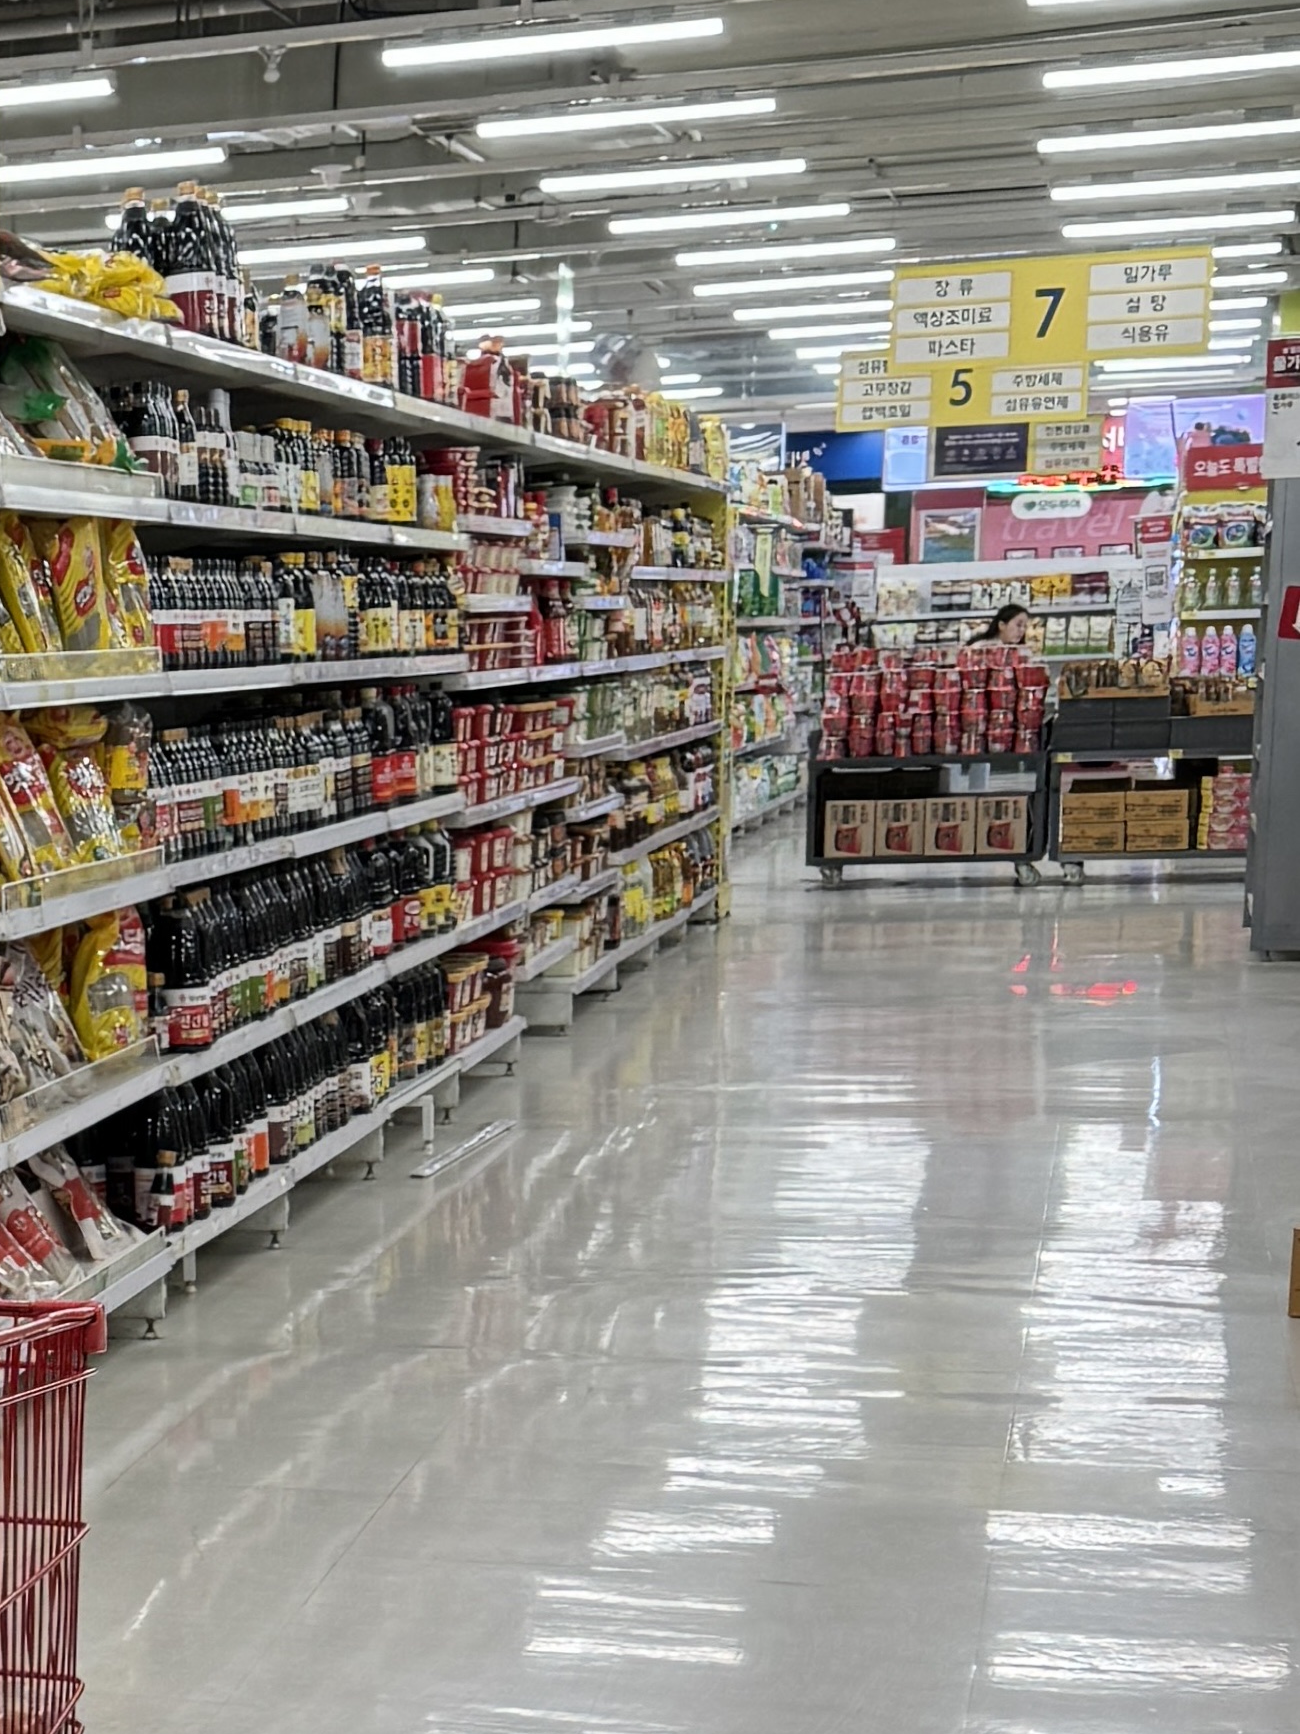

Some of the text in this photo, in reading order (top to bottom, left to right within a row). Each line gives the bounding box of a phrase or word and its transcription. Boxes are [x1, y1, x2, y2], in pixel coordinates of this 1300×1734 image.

[1124, 263, 1173, 284] 밀가루
[1034, 287, 1066, 339] 7
[928, 338, 976, 357] 파스타
[1121, 324, 1169, 343] 식용유
[949, 368, 974, 406] 5
[1002, 501, 1125, 541] travel
